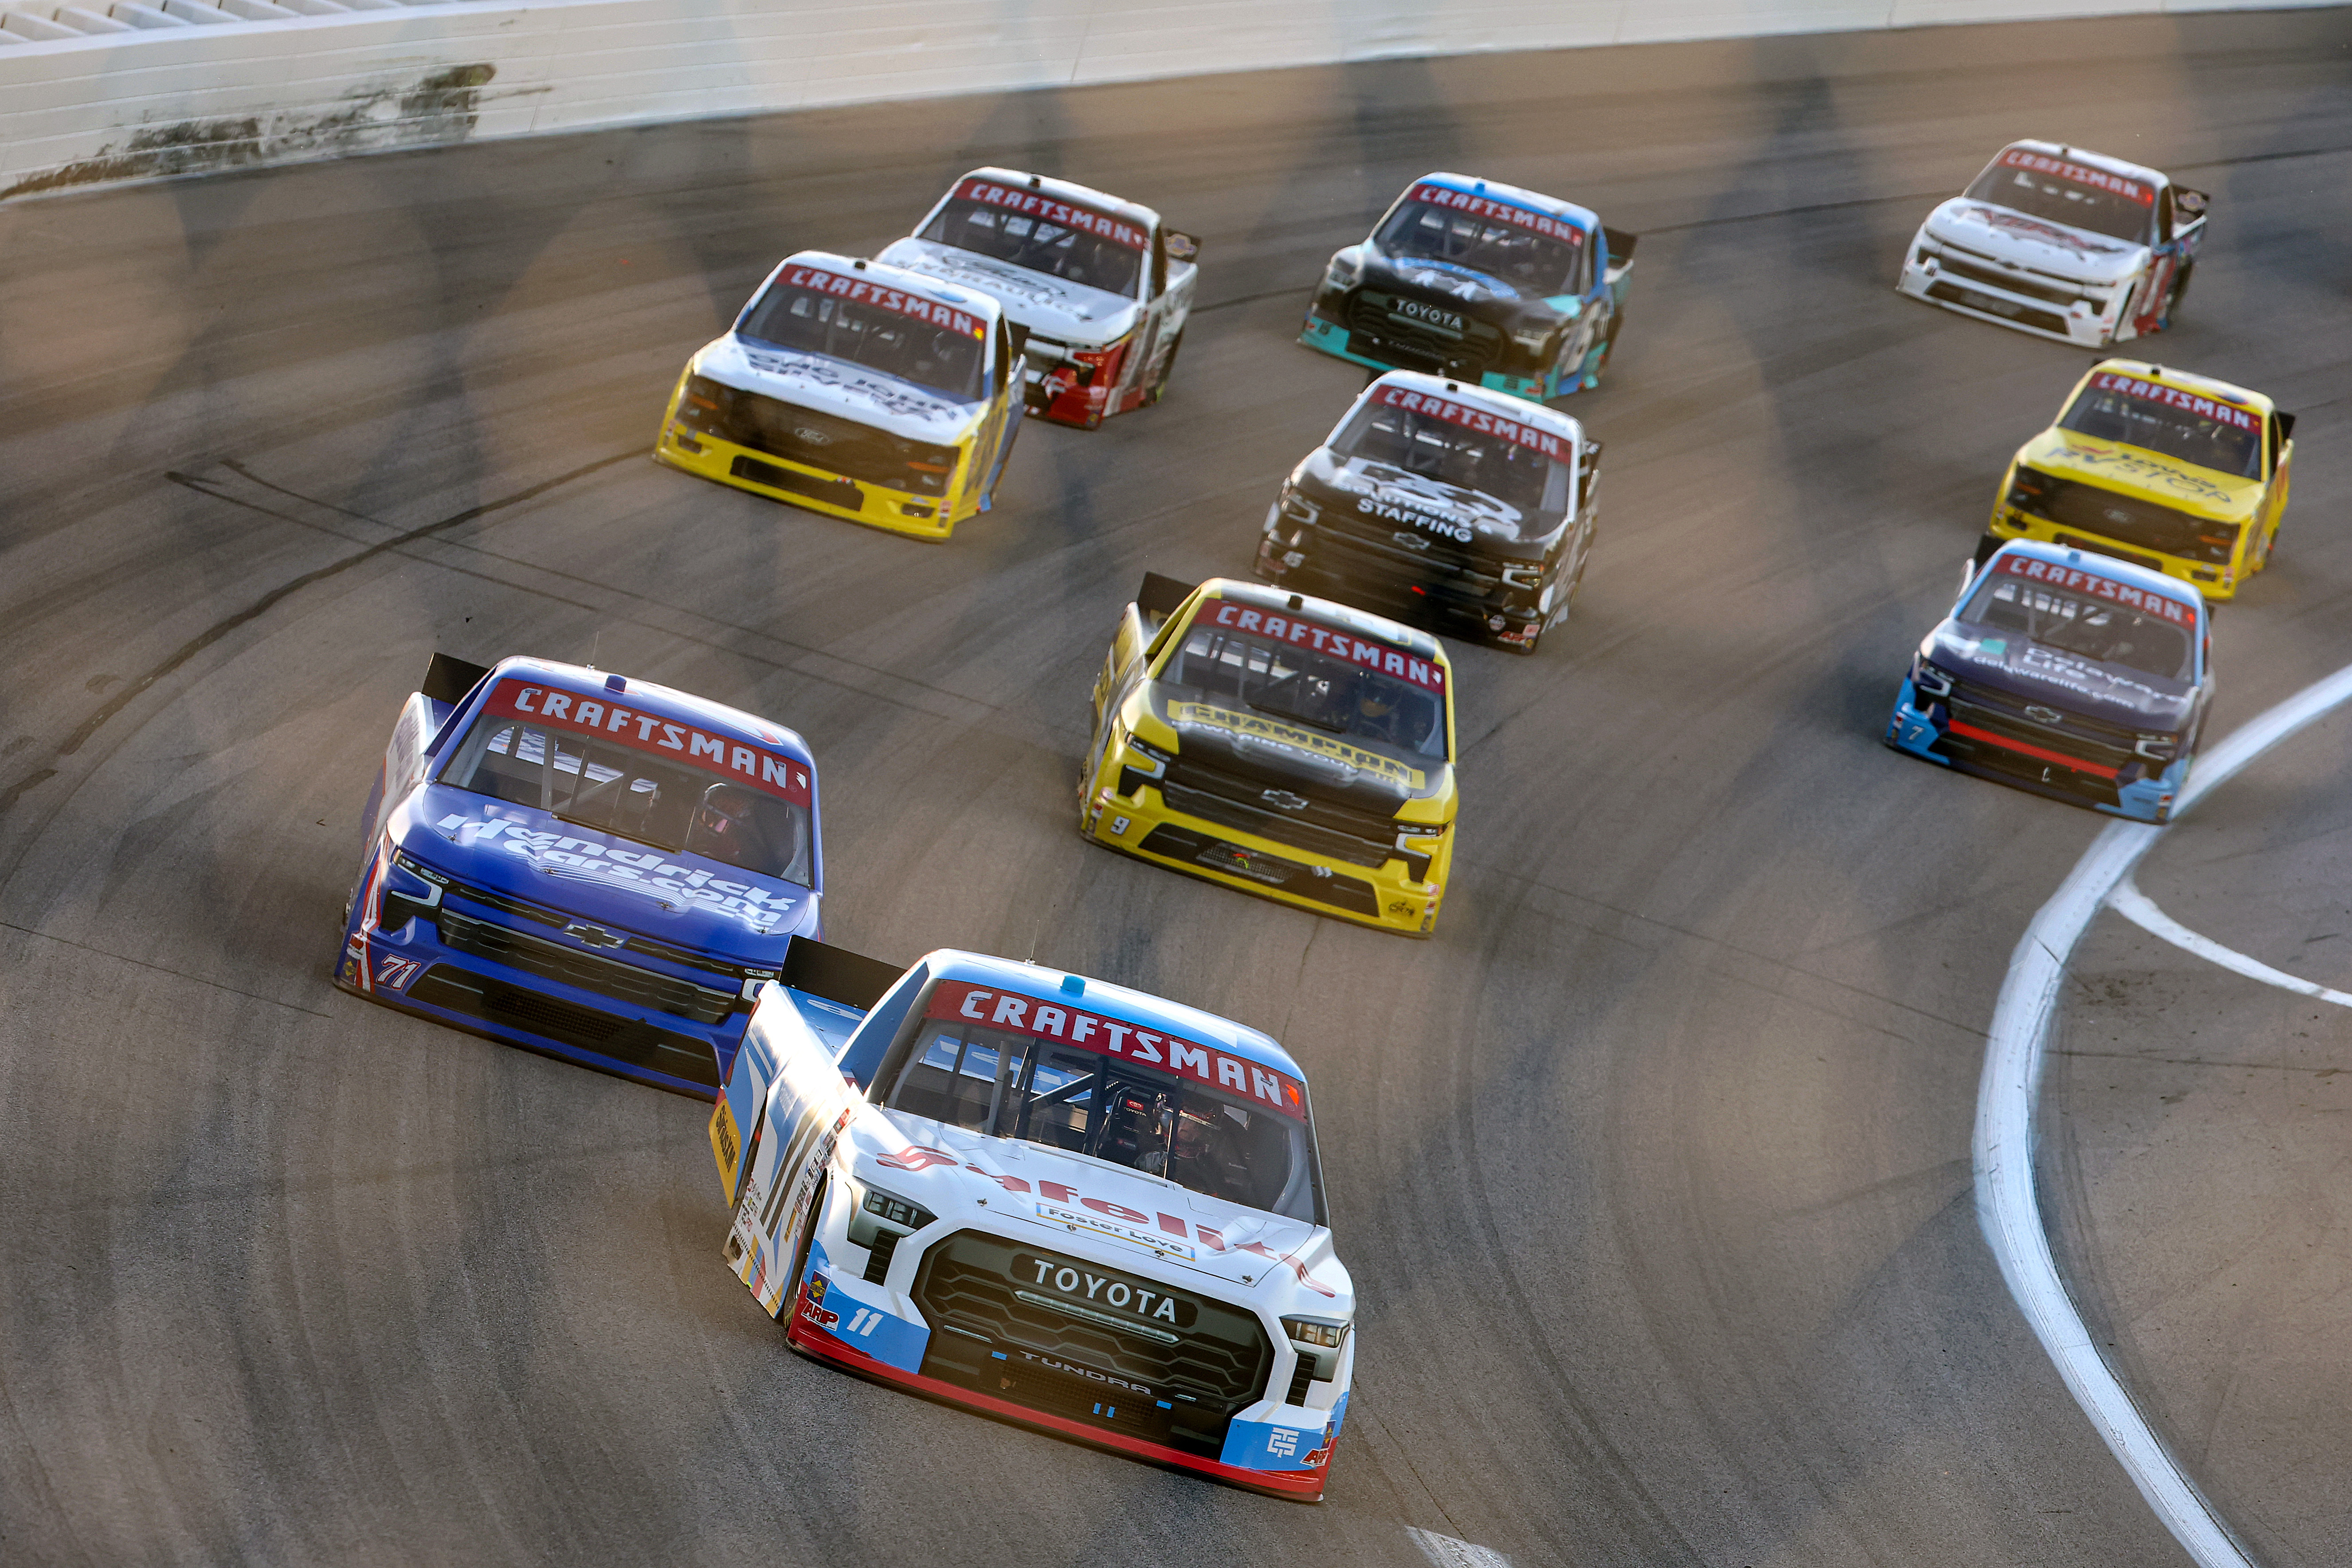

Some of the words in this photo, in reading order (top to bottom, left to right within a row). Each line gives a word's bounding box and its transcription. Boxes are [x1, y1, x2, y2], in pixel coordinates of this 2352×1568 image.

[2006, 152, 2140, 198] CRAFTSMAN
[970, 184, 1135, 243] CRAFTSMAN
[1419, 185, 1572, 240] CRAFTSMAN
[790, 268, 975, 335] CRAFTSMAN
[1396, 298, 1462, 330] TOYOTA
[1384, 388, 1559, 455] CRAFTSMAN
[2098, 374, 2250, 429] CRAFTSMAN
[1357, 498, 1473, 543] STAFFING
[2010, 557, 2182, 622] CRAFTSMAN
[1216, 605, 1428, 685] CRAFTSMAN
[514, 688, 788, 789] CRAFTSMAN
[1908, 725, 1924, 740] 7
[1110, 815, 1131, 835] 9
[436, 813, 796, 912] Hendrick
[376, 953, 421, 990] 71
[959, 990, 1284, 1107] CRAFTSMAN
[1123, 1107, 1147, 1117] TOYOTA
[1049, 1207, 1136, 1239] Foster
[1140, 1230, 1183, 1254] Love
[802, 1301, 839, 1325] ARP
[1033, 1258, 1176, 1325] TOYOTA
[846, 1307, 884, 1337] 11
[1019, 1350, 1151, 1395] TUNDRA
